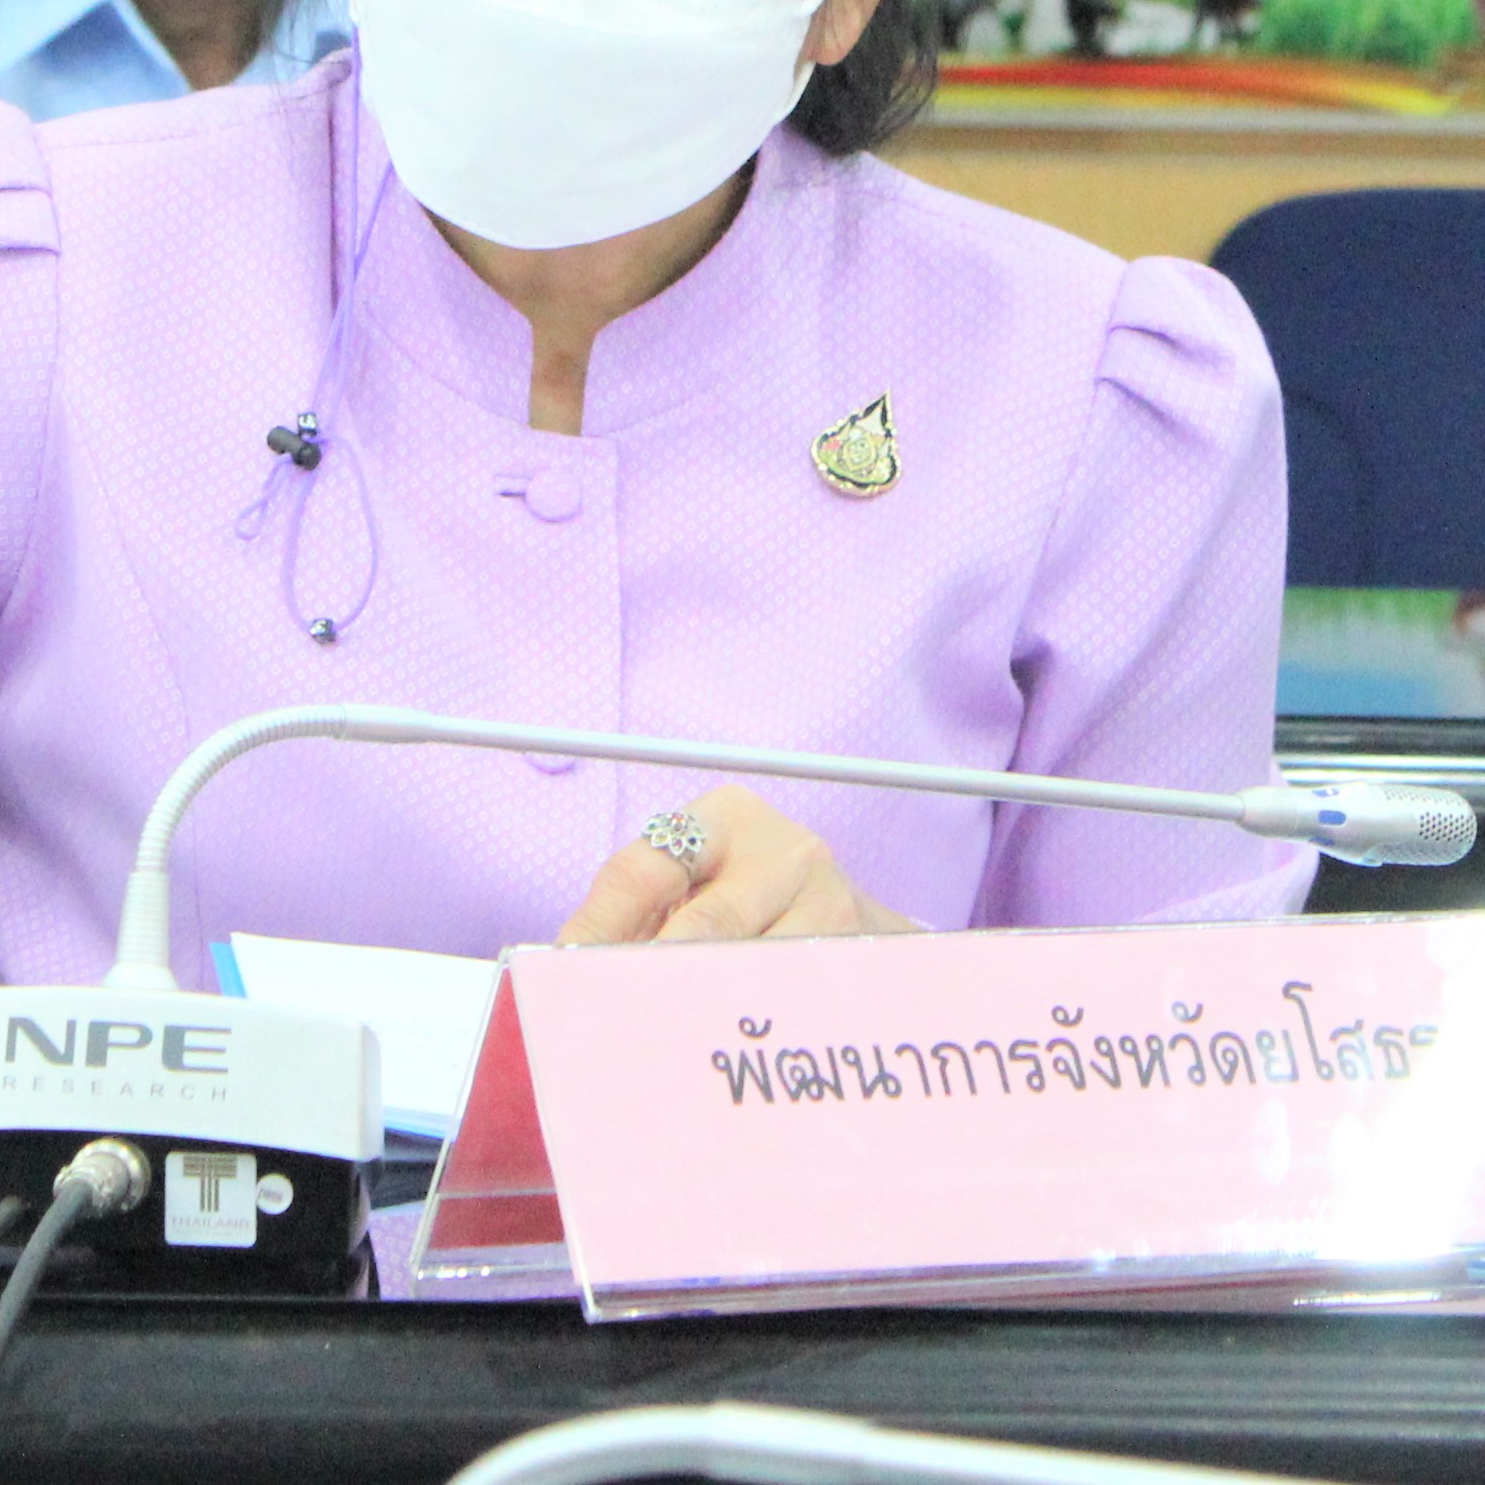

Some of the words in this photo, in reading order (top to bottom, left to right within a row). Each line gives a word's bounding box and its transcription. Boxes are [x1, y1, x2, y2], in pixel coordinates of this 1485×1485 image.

[4, 1016, 233, 1075] NPE
[2, 1075, 228, 1102] RESEARCH
[171, 1216, 250, 1230] THAILAND
